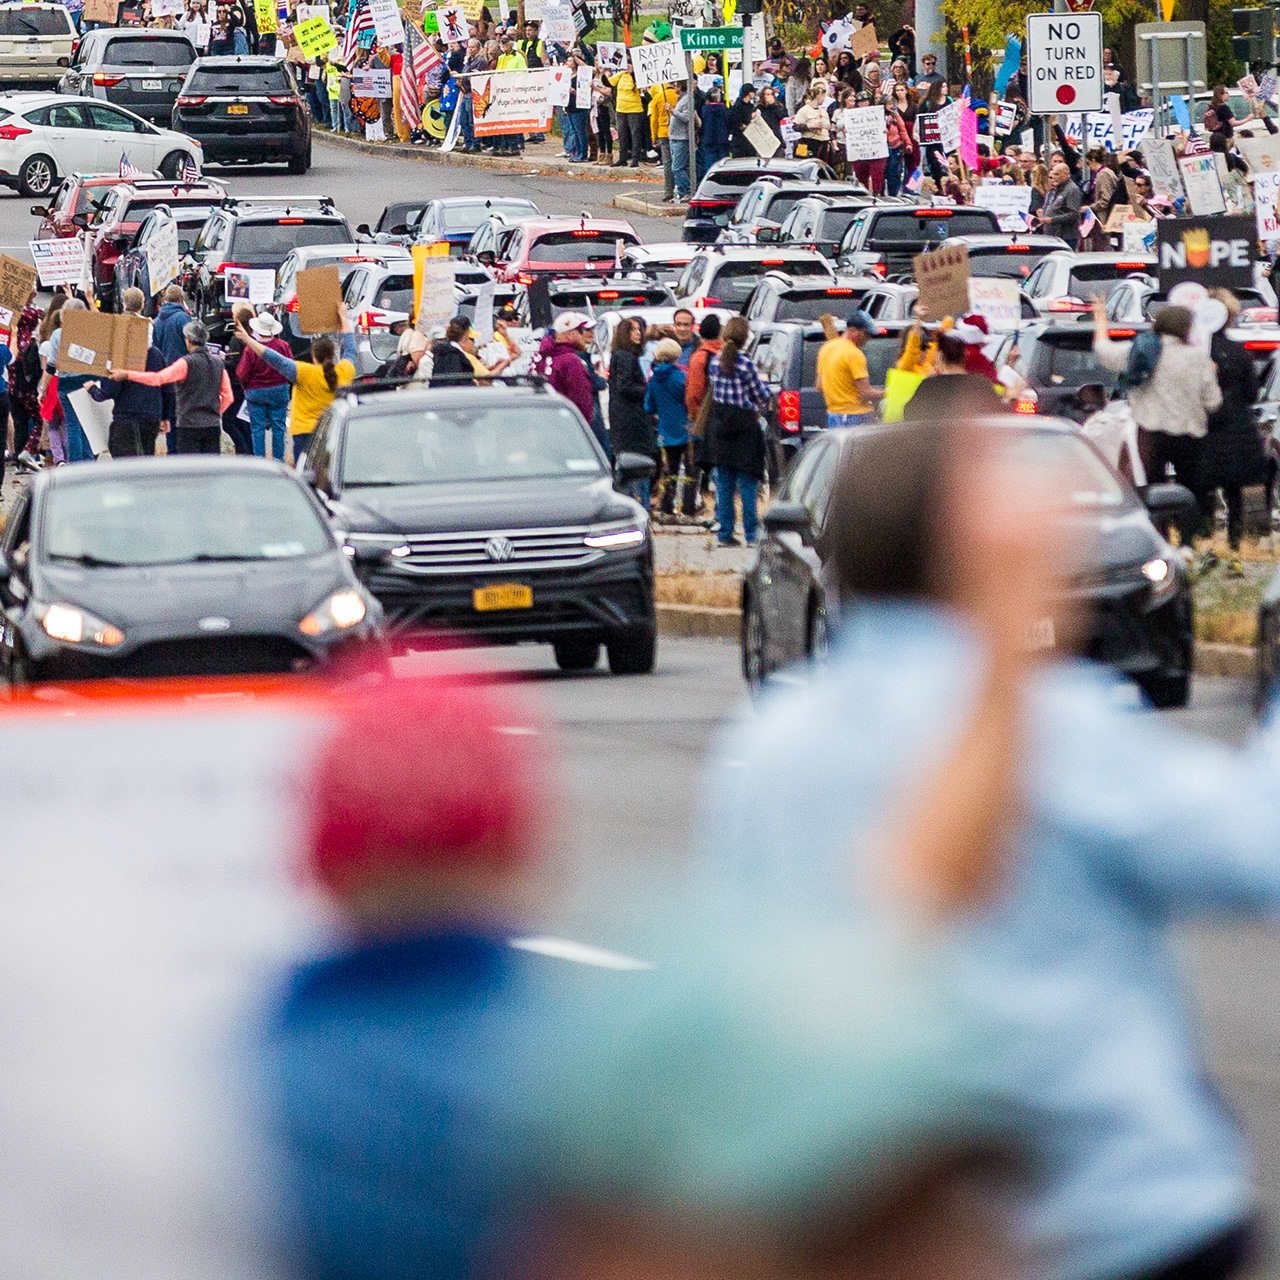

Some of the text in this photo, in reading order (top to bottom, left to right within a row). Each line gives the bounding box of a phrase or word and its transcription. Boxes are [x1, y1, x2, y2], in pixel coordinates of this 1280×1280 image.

[1048, 22, 1081, 40] NO
[687, 32, 743, 46] Kinne Rd
[639, 42, 678, 61] RAPIST
[1045, 47, 1086, 60] TURN
[641, 57, 673, 72] NOT A
[646, 71, 679, 87] KING
[1036, 66, 1095, 81] ON RED
